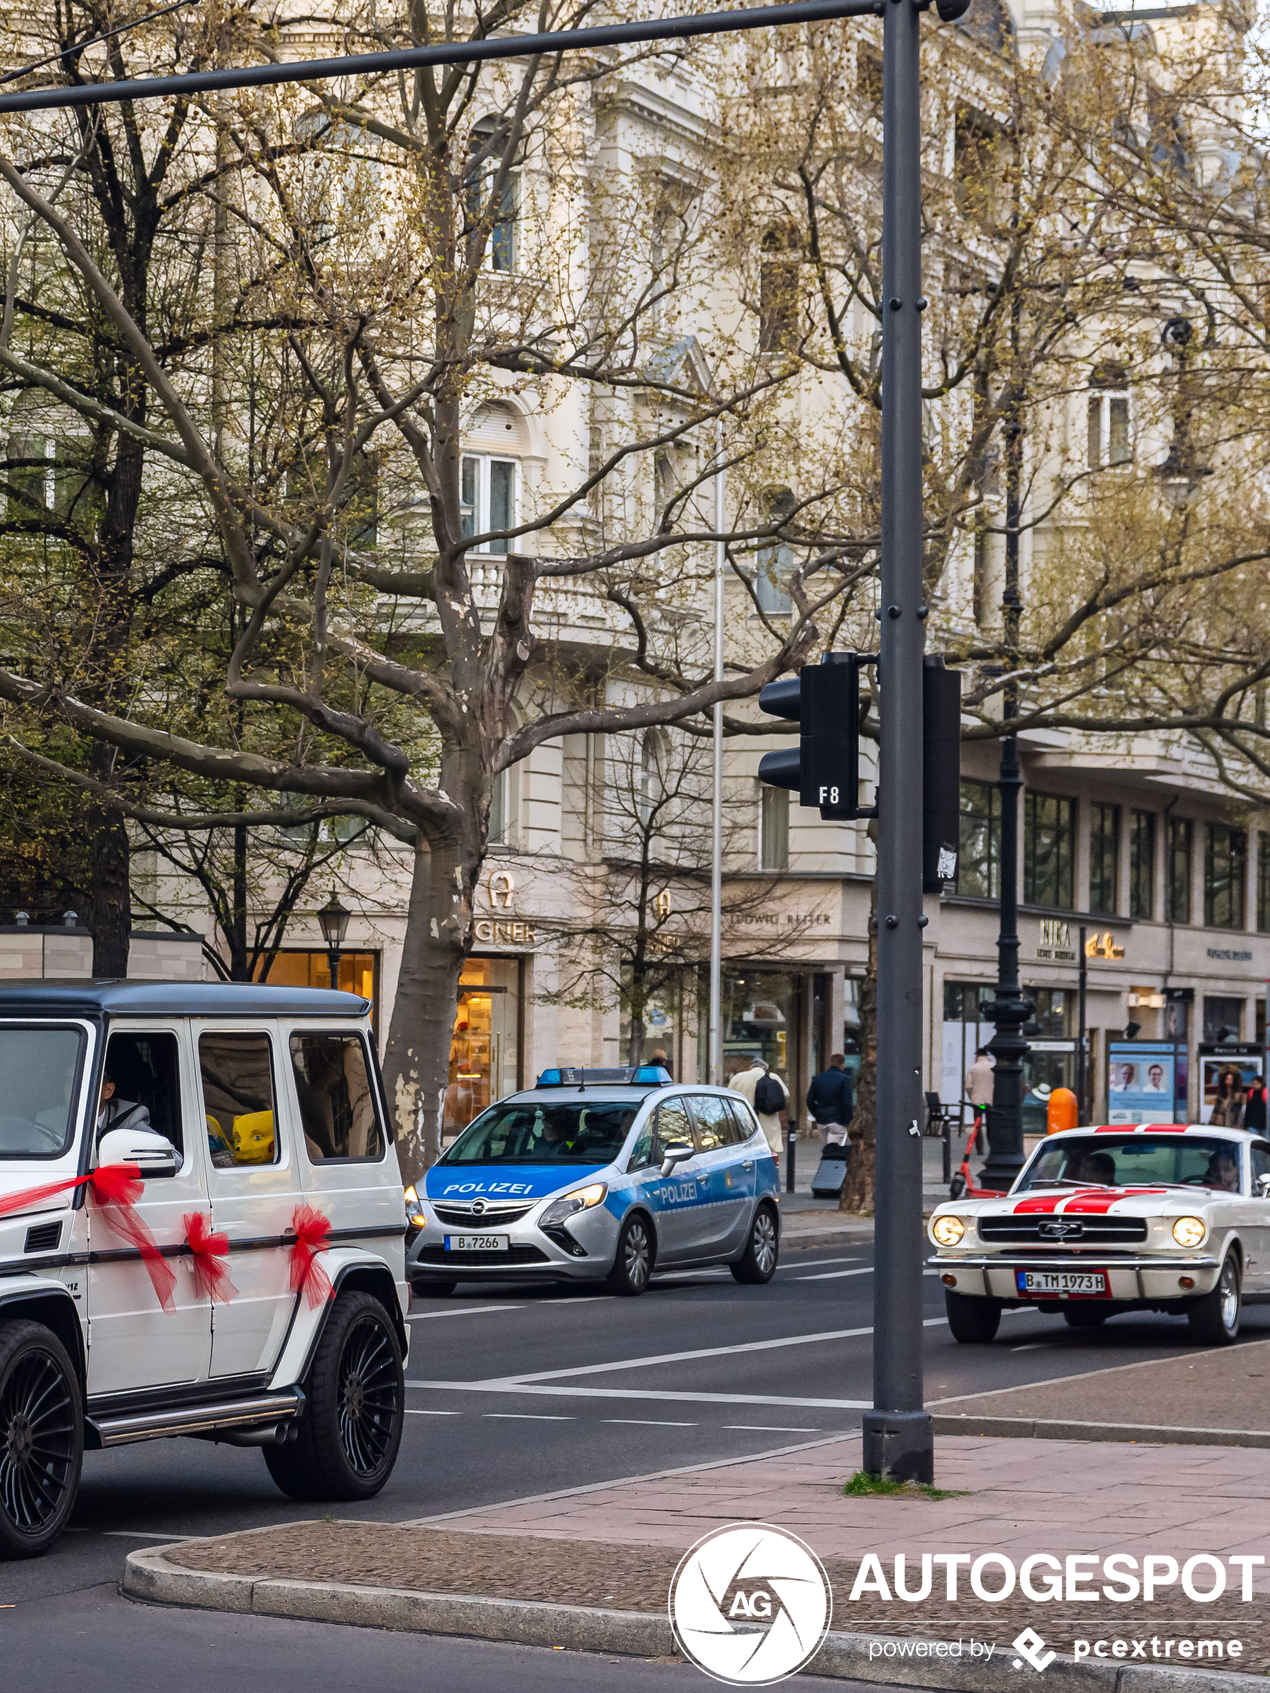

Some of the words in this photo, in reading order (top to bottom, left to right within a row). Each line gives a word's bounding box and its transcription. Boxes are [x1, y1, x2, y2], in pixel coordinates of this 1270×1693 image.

[819, 786, 840, 804] F8
[788, 914, 830, 924] REITER
[442, 1182, 534, 1194] POLIZEI
[660, 1182, 698, 1204] POLIZEI
[472, 1238, 498, 1248] 7266
